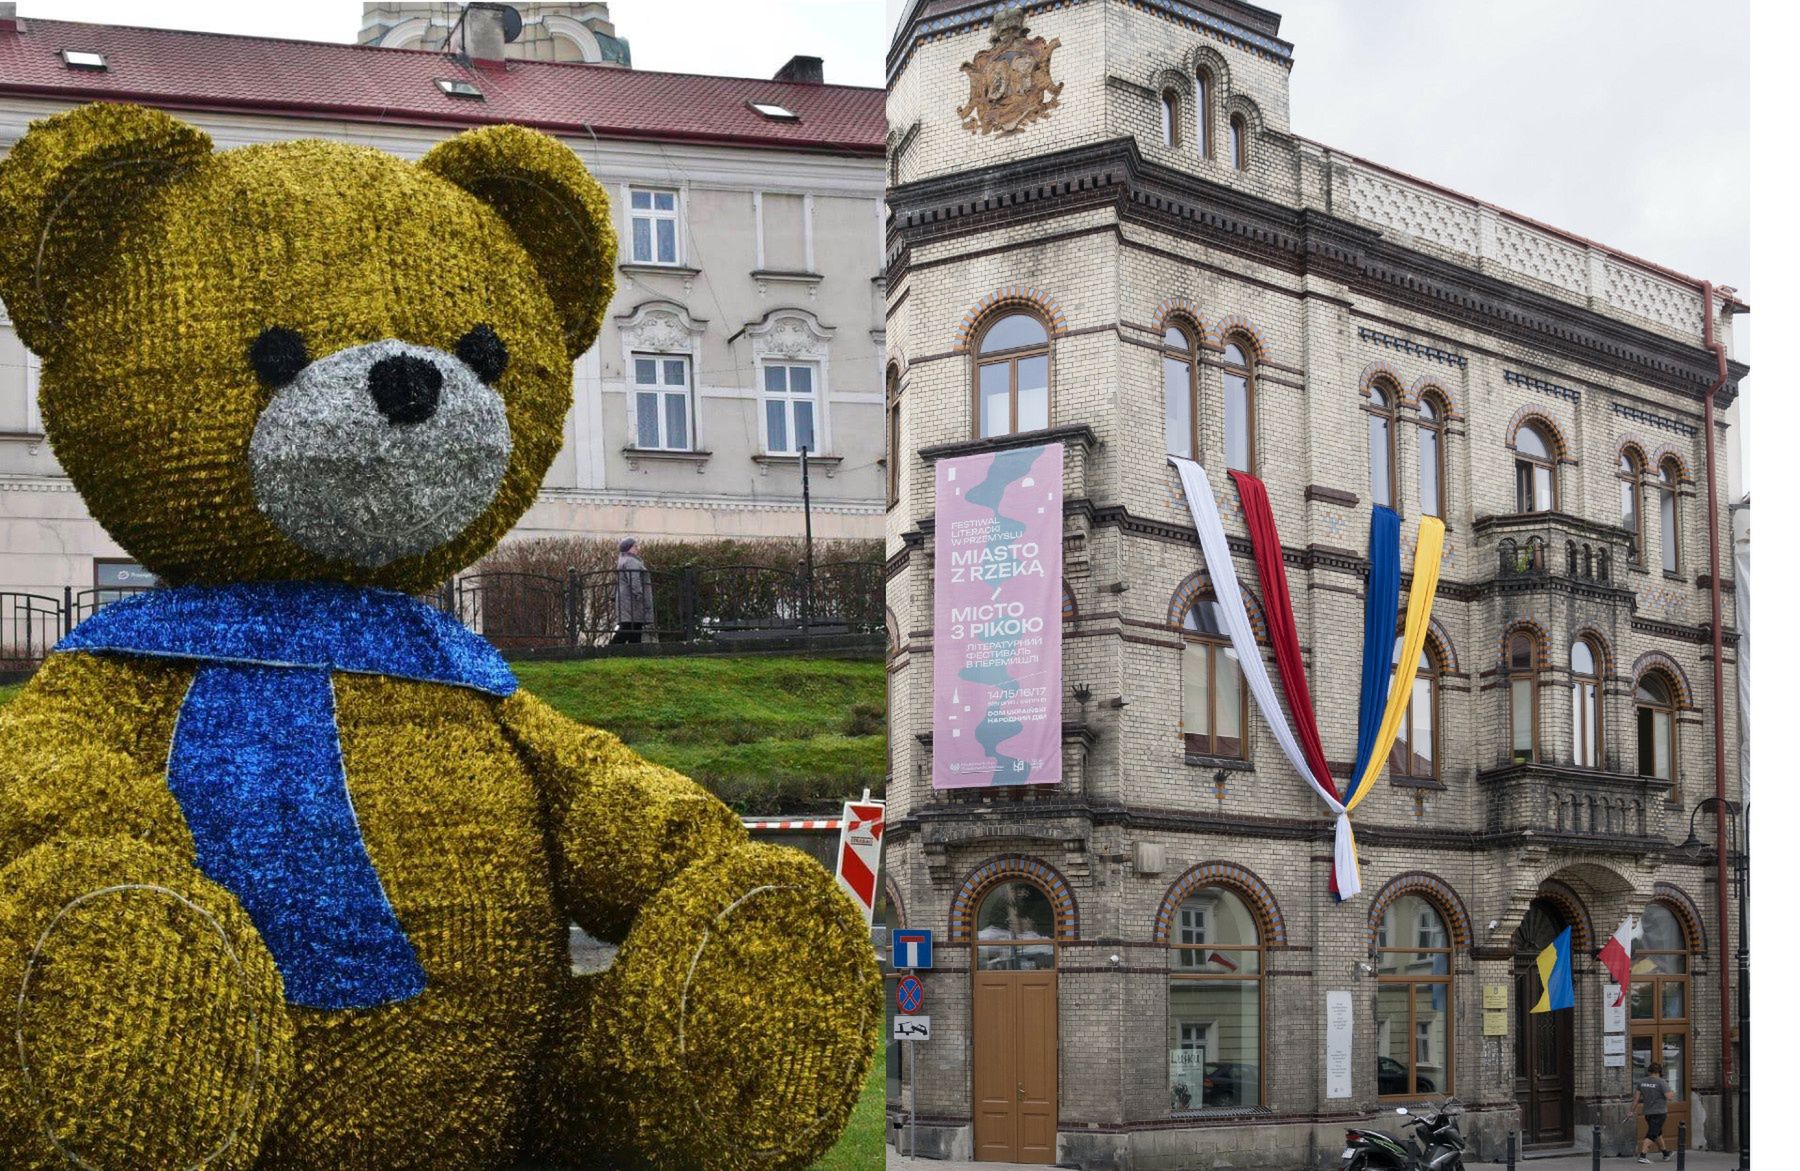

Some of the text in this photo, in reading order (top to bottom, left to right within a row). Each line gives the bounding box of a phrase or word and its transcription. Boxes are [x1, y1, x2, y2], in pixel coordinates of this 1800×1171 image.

[952, 517, 1000, 529] FESTIWAL
[952, 525, 1001, 538] LITERACKI
[952, 531, 1023, 546] W PRZEMYŚLU
[952, 543, 1039, 566] MIASTO
[951, 560, 1045, 583] Z RZEKĄ
[951, 602, 1024, 623] МІСТО
[970, 617, 1044, 638] РІКОЮ
[966, 648, 1031, 660] ФЕСТИВАЛЬ
[987, 687, 1047, 699] 14/15/16/17
